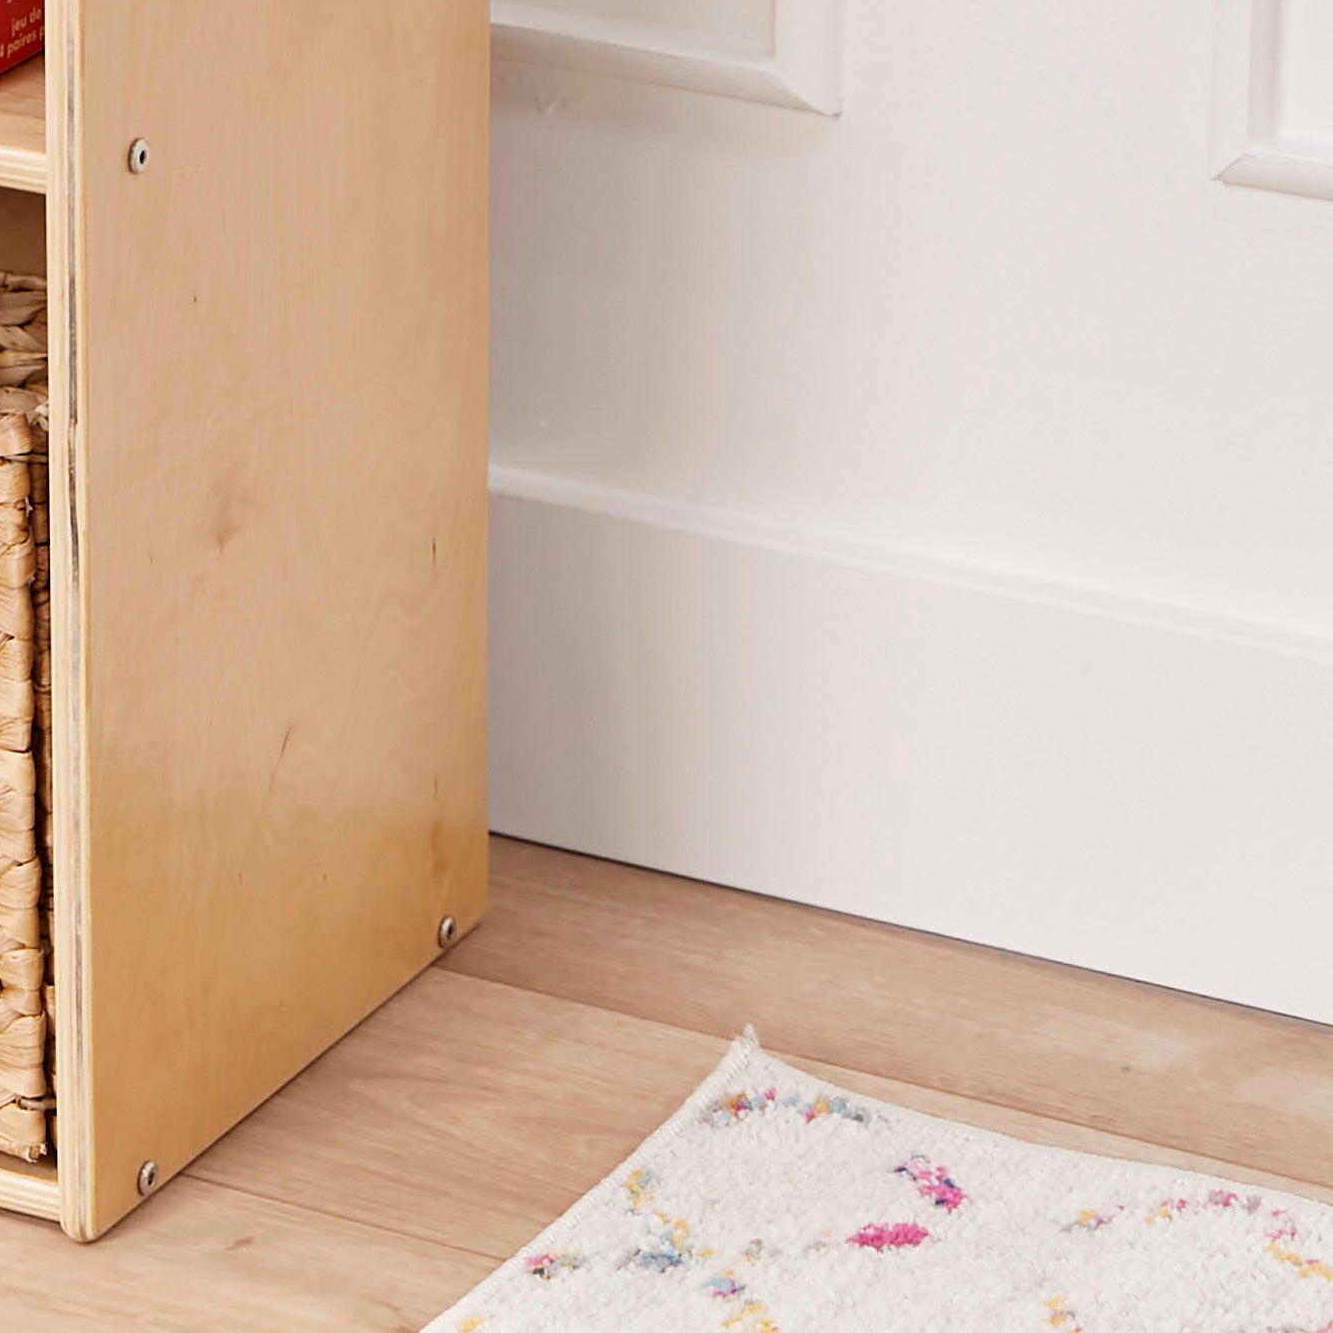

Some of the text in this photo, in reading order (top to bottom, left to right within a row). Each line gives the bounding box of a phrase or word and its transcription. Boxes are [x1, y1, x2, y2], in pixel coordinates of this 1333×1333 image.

[11, 6, 42, 38] jeu de
[7, 30, 37, 59] paires
